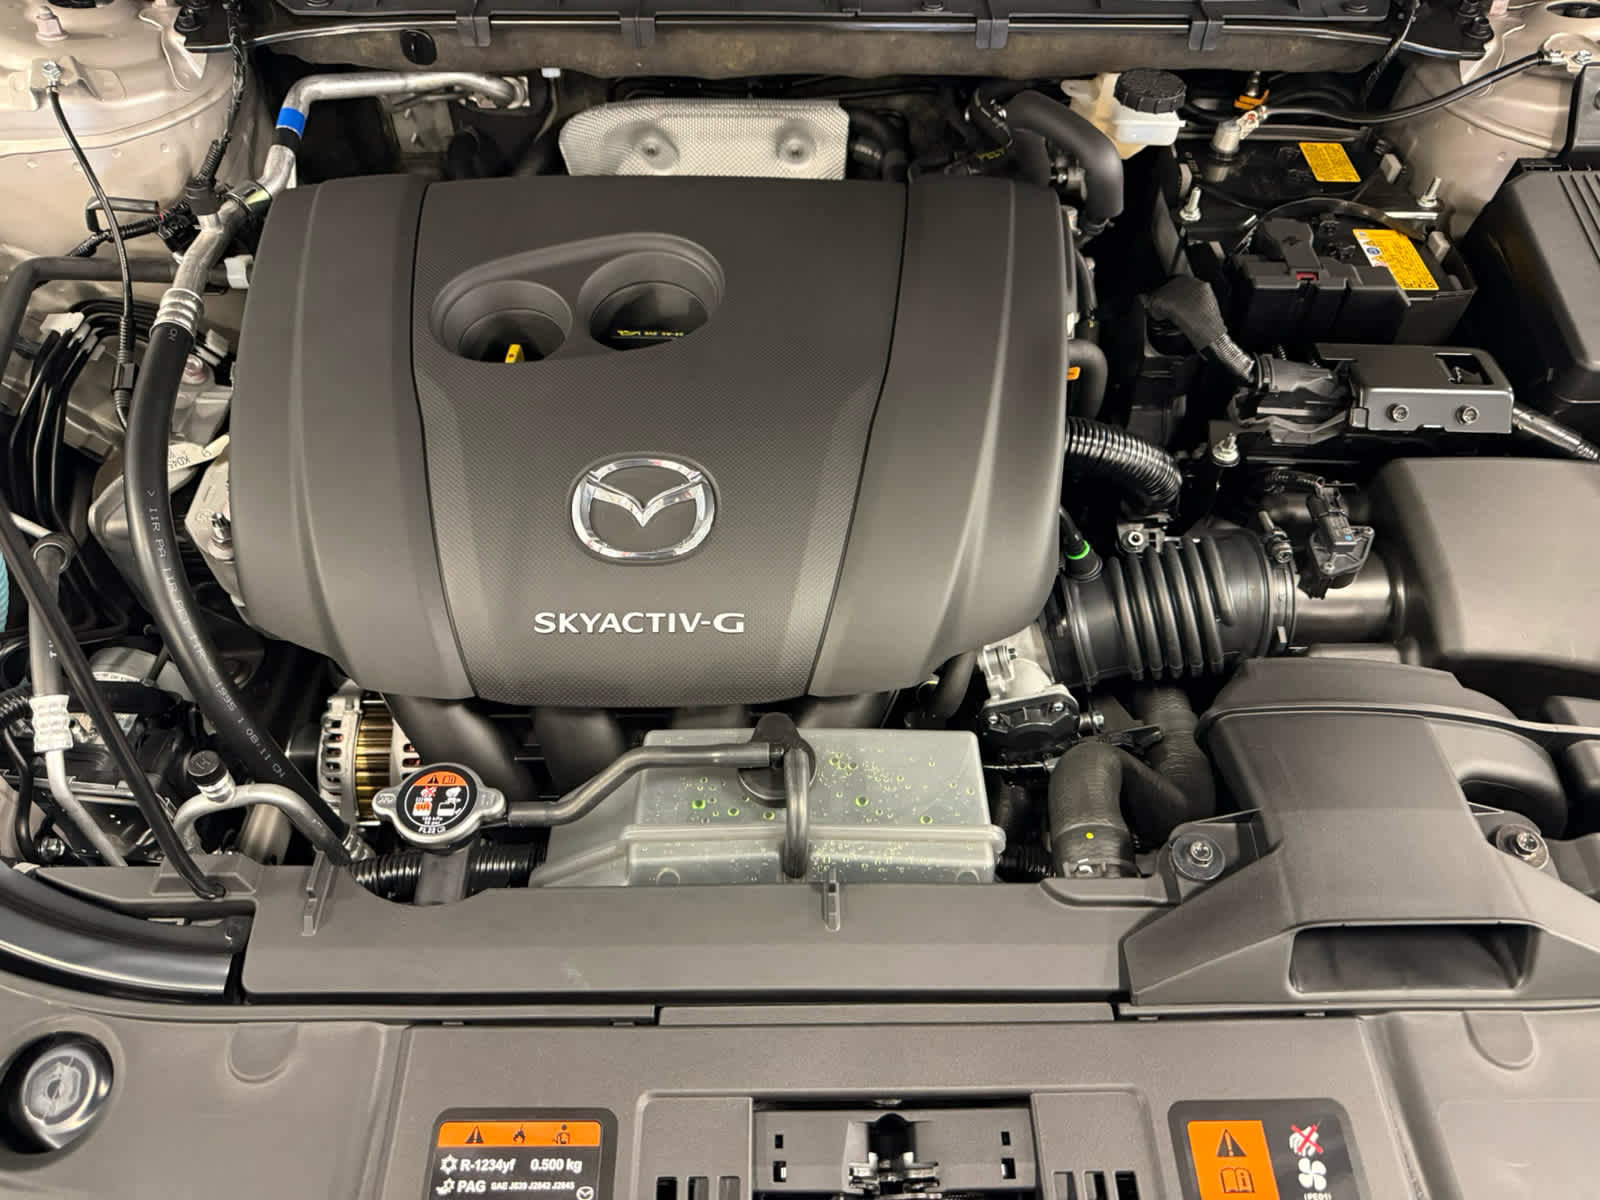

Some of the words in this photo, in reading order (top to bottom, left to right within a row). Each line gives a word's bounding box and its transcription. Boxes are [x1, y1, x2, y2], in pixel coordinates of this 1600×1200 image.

[534, 612, 744, 634] SKYACTIV-G
[459, 1158, 516, 1174] R-1234yf
[530, 1159, 564, 1171] 0.500
[566, 1158, 583, 1174] kg
[456, 1180, 487, 1193] PAG
